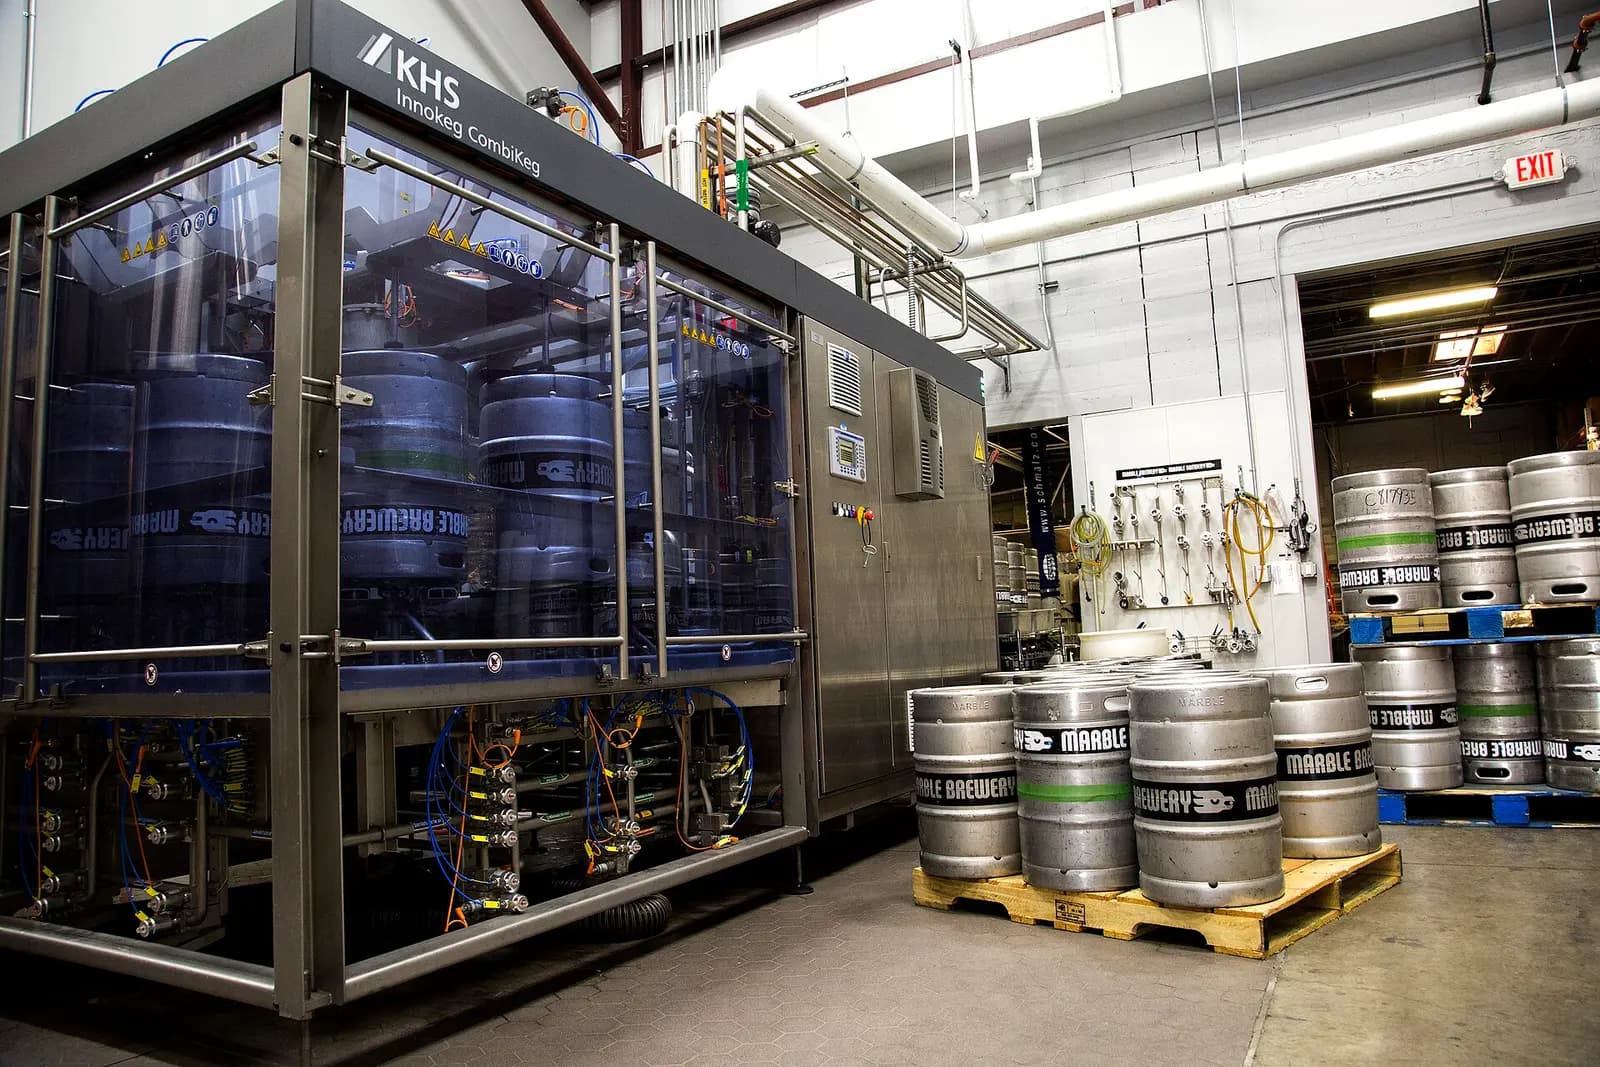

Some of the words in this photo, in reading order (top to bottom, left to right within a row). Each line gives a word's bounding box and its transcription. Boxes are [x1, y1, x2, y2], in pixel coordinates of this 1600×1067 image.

[397, 47, 460, 110] KHS
[397, 87, 463, 140] Innokeg
[468, 125, 540, 178] CombiKeg
[1516, 151, 1554, 183] EXIT
[1030, 431, 1049, 533] www.schmalz.co
[342, 508, 433, 533] BREWERY
[438, 509, 470, 537] RBLE
[1529, 516, 1594, 539] BREWERY
[1438, 531, 1463, 549] BRE
[1465, 526, 1513, 547] MARBLE
[1380, 708, 1434, 727] MARBLE
[1061, 727, 1127, 752] MARBLE
[1490, 739, 1542, 758] MARBLE
[1286, 751, 1351, 775] MARBLE
[1354, 747, 1374, 771] BRE
[916, 776, 942, 799] RBLE
[945, 776, 1016, 800] BREWERY
